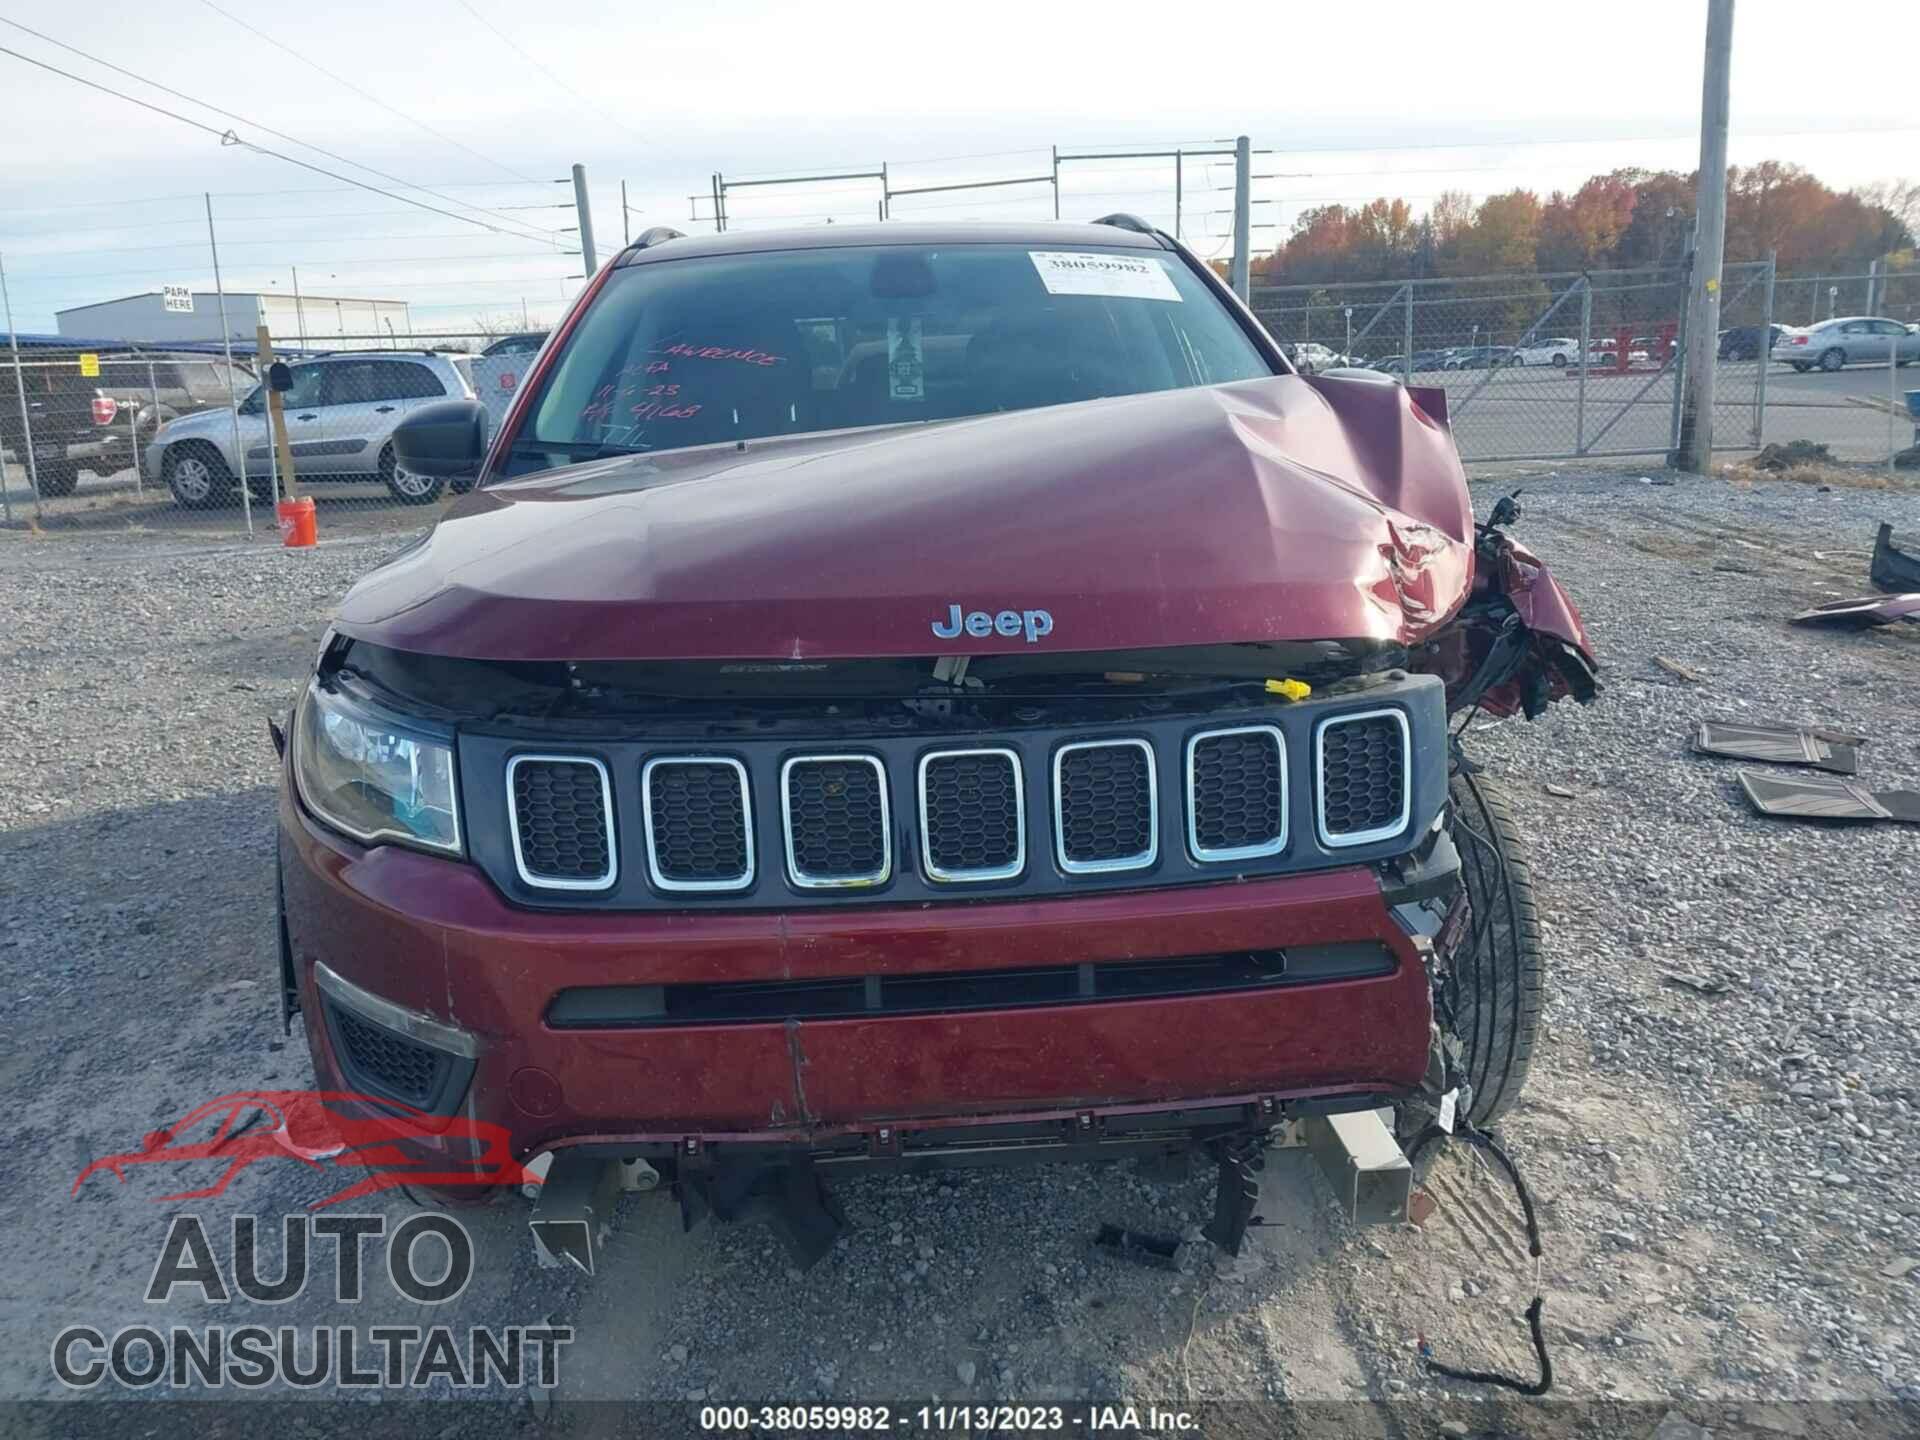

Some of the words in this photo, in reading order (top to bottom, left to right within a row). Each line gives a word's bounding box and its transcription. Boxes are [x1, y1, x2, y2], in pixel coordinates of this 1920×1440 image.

[1049, 259, 1151, 274] 38059982
[163, 286, 190, 296] PARK
[166, 299, 192, 310] HERE
[931, 604, 1054, 643] Jeep
